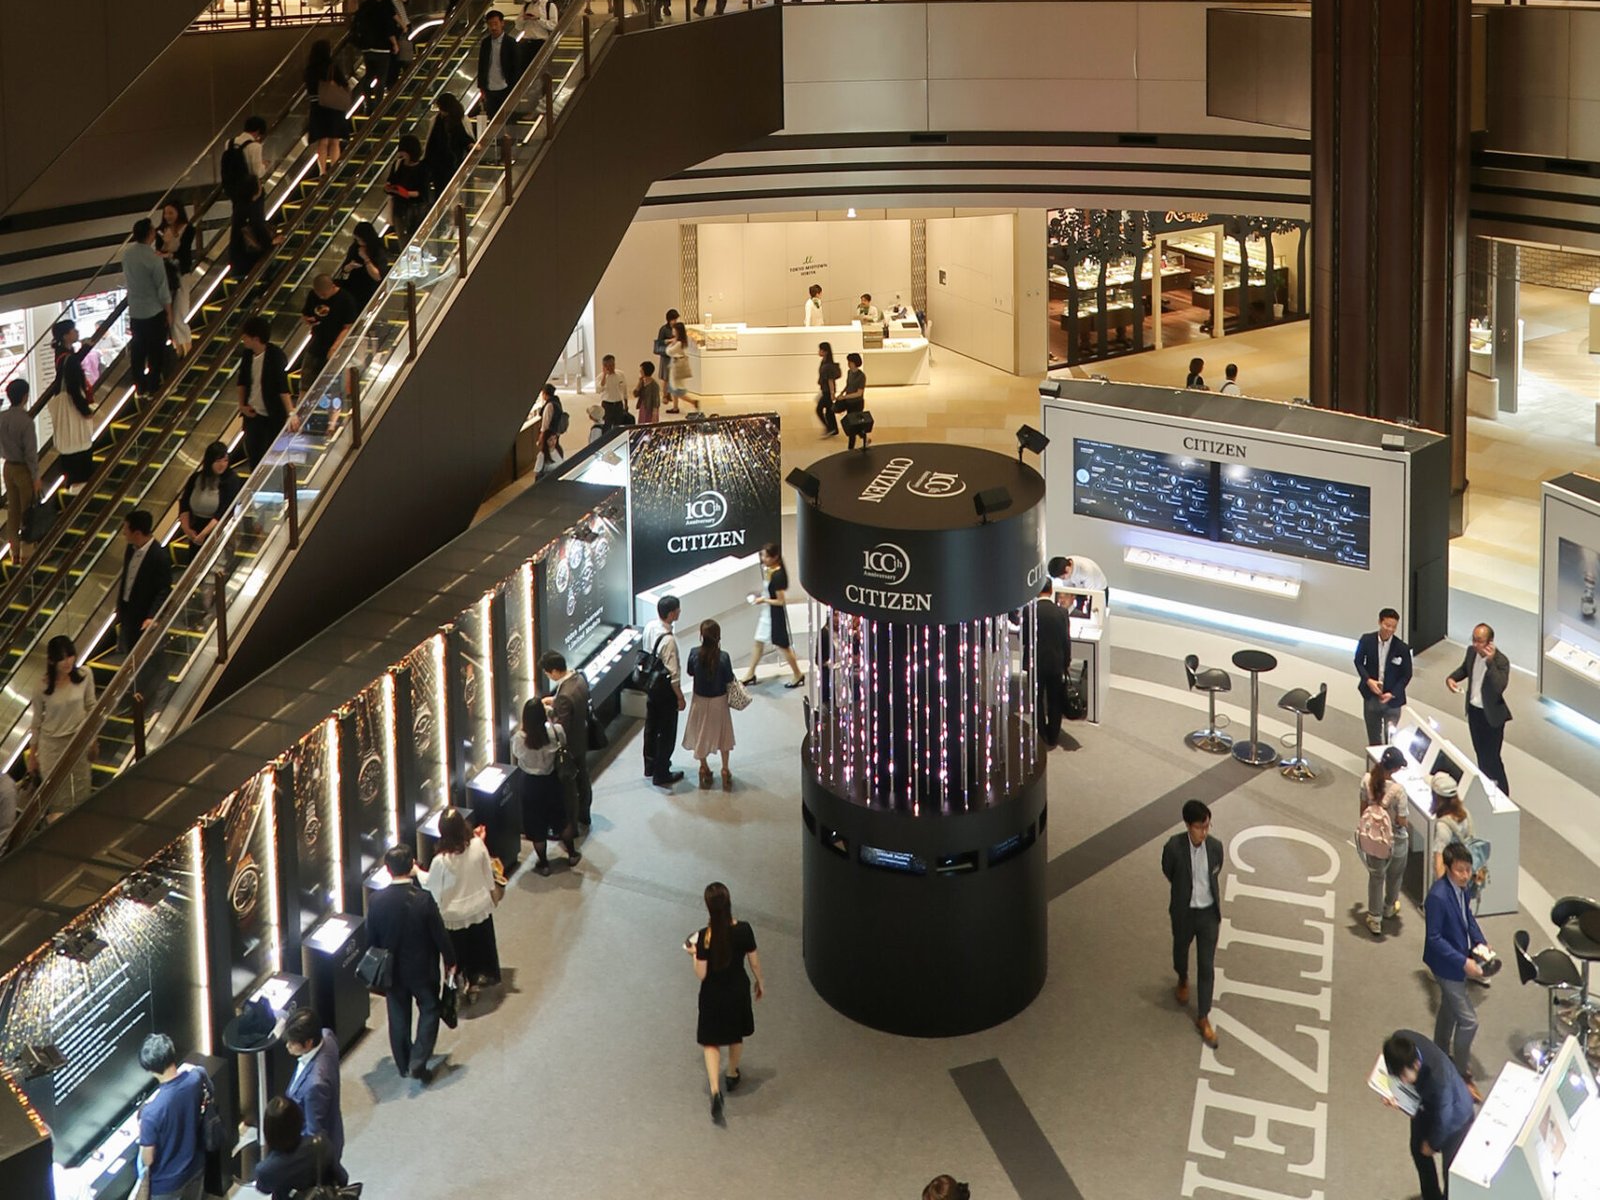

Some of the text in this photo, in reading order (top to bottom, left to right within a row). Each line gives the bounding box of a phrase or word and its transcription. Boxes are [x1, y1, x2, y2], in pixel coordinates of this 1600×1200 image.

[1183, 436, 1248, 459] CITIZEN
[858, 457, 914, 503] CITIZEN
[667, 529, 746, 553] CITIZEN
[845, 584, 932, 611] CITIZEN
